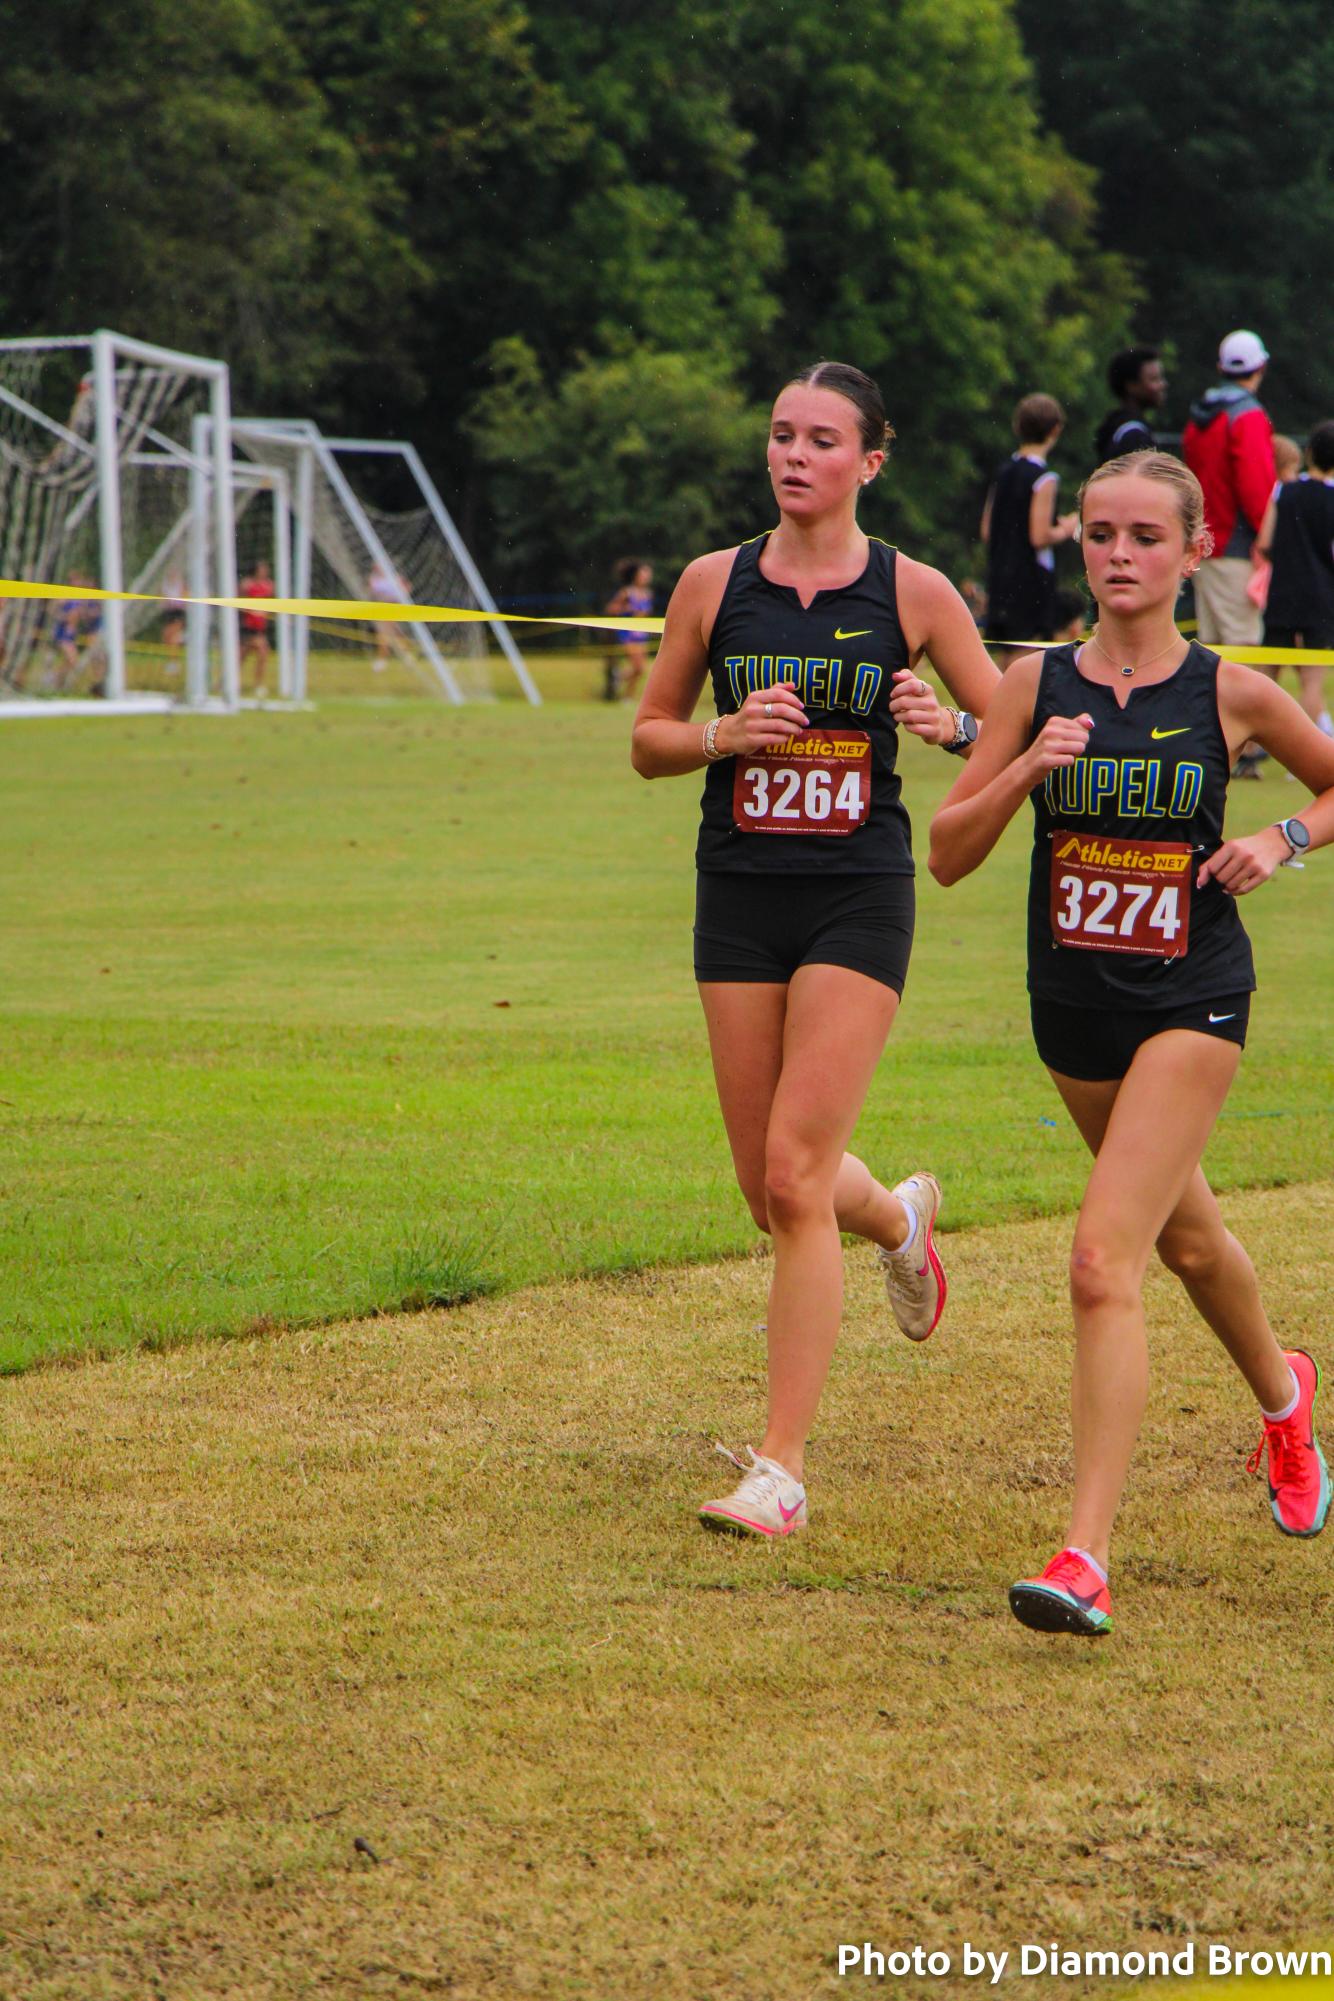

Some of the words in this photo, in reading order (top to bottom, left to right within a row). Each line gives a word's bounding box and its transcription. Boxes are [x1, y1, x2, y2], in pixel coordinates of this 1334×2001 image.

[725, 655, 883, 716] TUPELO
[765, 735, 834, 756] thletic
[837, 745, 865, 755] NET
[743, 767, 865, 820] 3264
[1055, 837, 1153, 870] Athletic
[1157, 857, 1185, 868] NET
[1057, 875, 1181, 940] 3274
